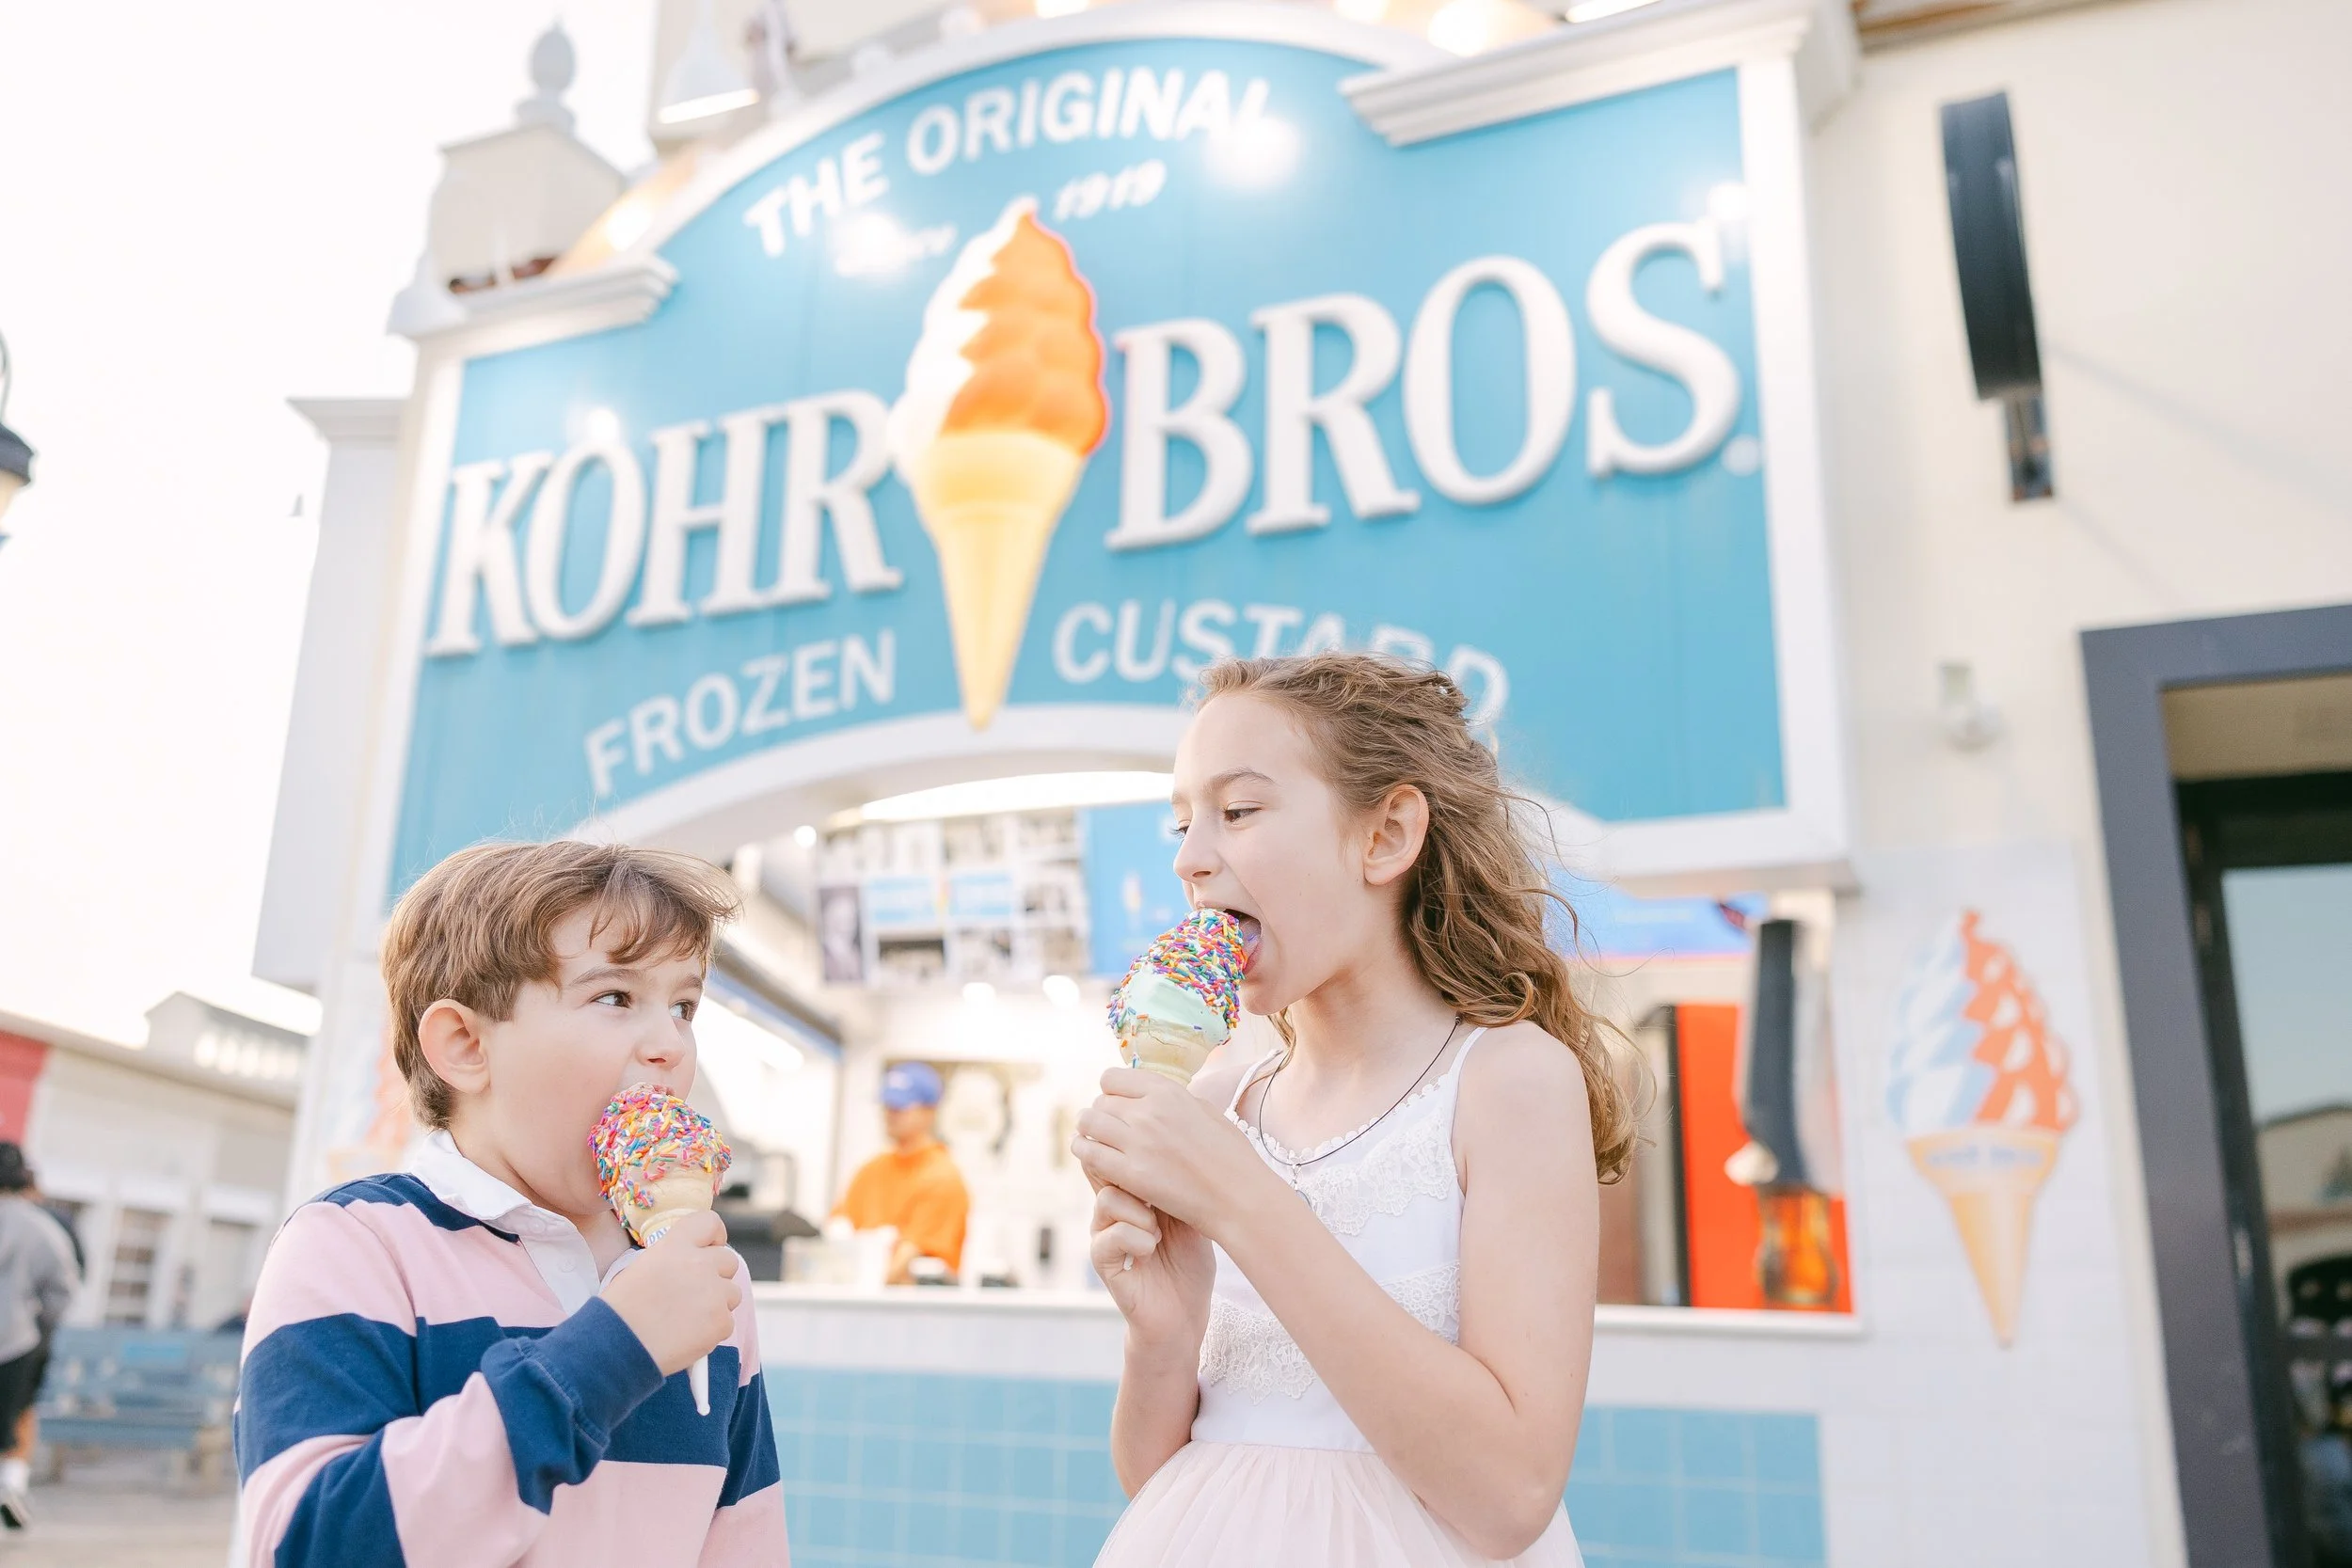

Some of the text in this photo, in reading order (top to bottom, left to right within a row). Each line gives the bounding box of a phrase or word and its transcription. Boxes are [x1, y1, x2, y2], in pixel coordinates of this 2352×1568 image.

[742, 130, 889, 257] THE
[422, 388, 903, 658] KOHR
[583, 628, 895, 798] FROZEN
